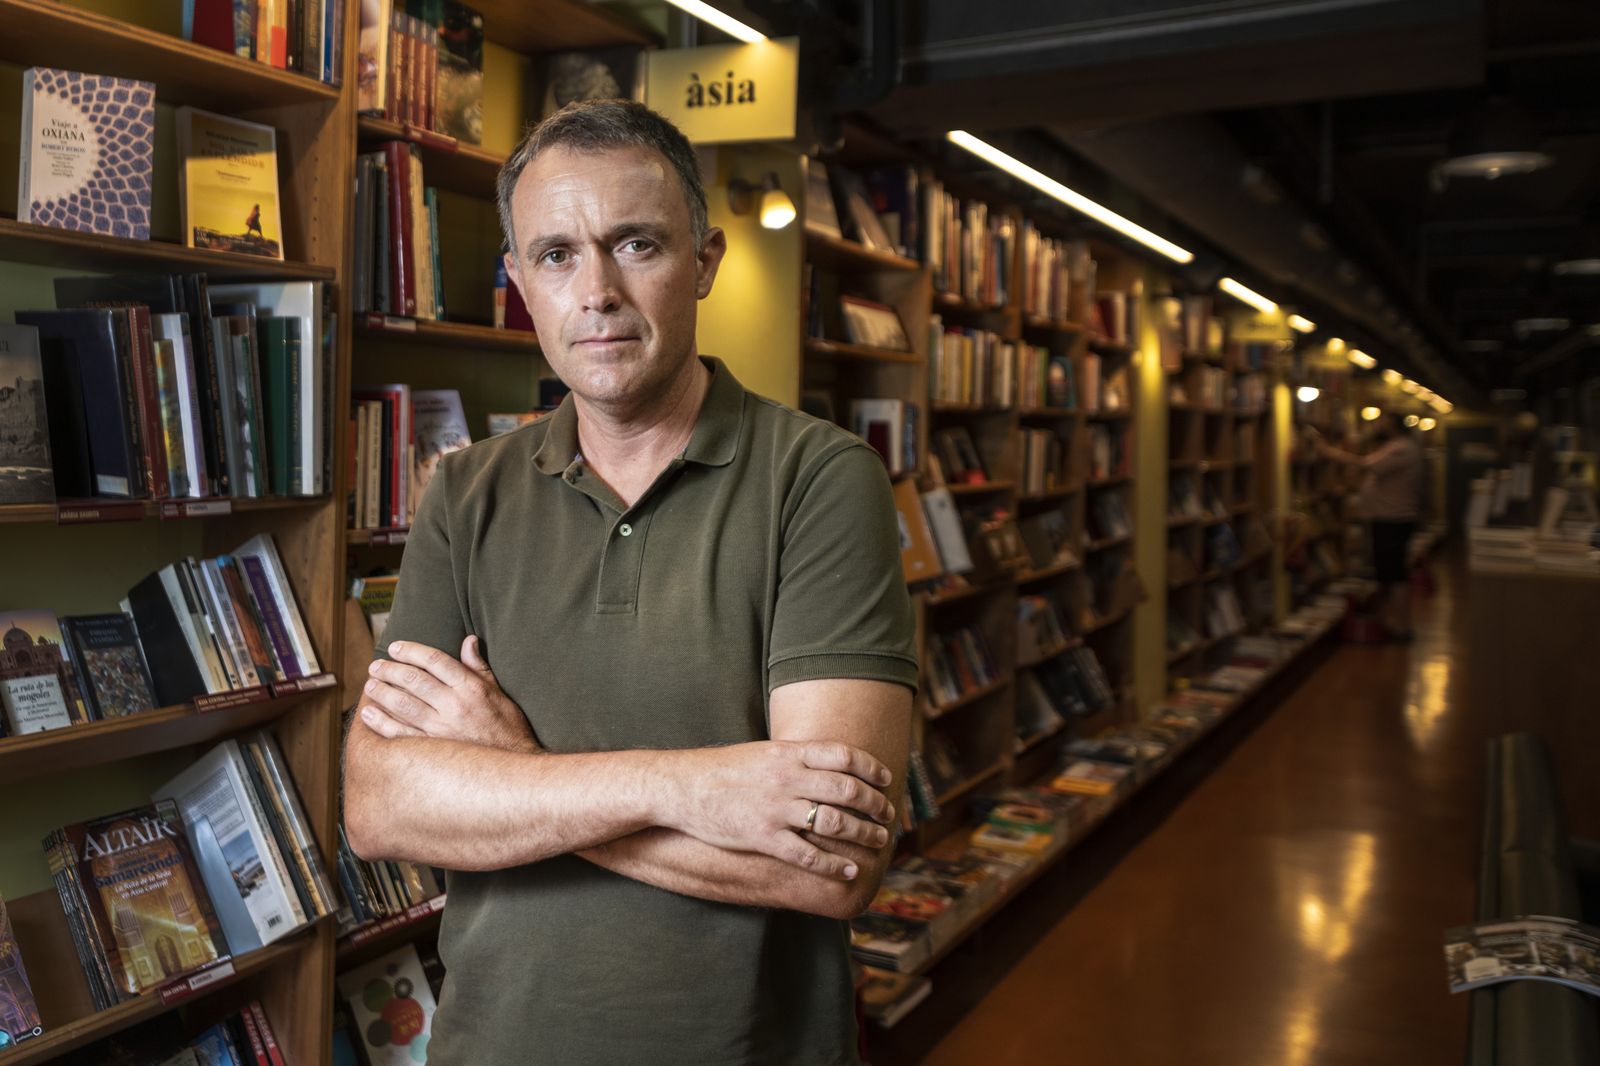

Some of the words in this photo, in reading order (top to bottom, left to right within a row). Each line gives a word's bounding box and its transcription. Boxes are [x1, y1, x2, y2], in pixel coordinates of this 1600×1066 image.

[686, 70, 756, 108] àsia
[51, 118, 71, 129] Viaje
[42, 127, 85, 142] OXIANA
[8, 685, 18, 694] La
[20, 683, 35, 692] ruta
[36, 680, 44, 689] de
[18, 689, 50, 704] mogoles
[83, 817, 178, 862] ALTAÏR
[95, 852, 183, 889] Samarcanda
[115, 884, 124, 893] La
[123, 879, 140, 890] Ruta
[140, 877, 148, 885] de
[148, 874, 156, 882] la
[156, 870, 172, 880] Seda
[121, 891, 130, 899] en
[145, 879, 169, 893] Central
